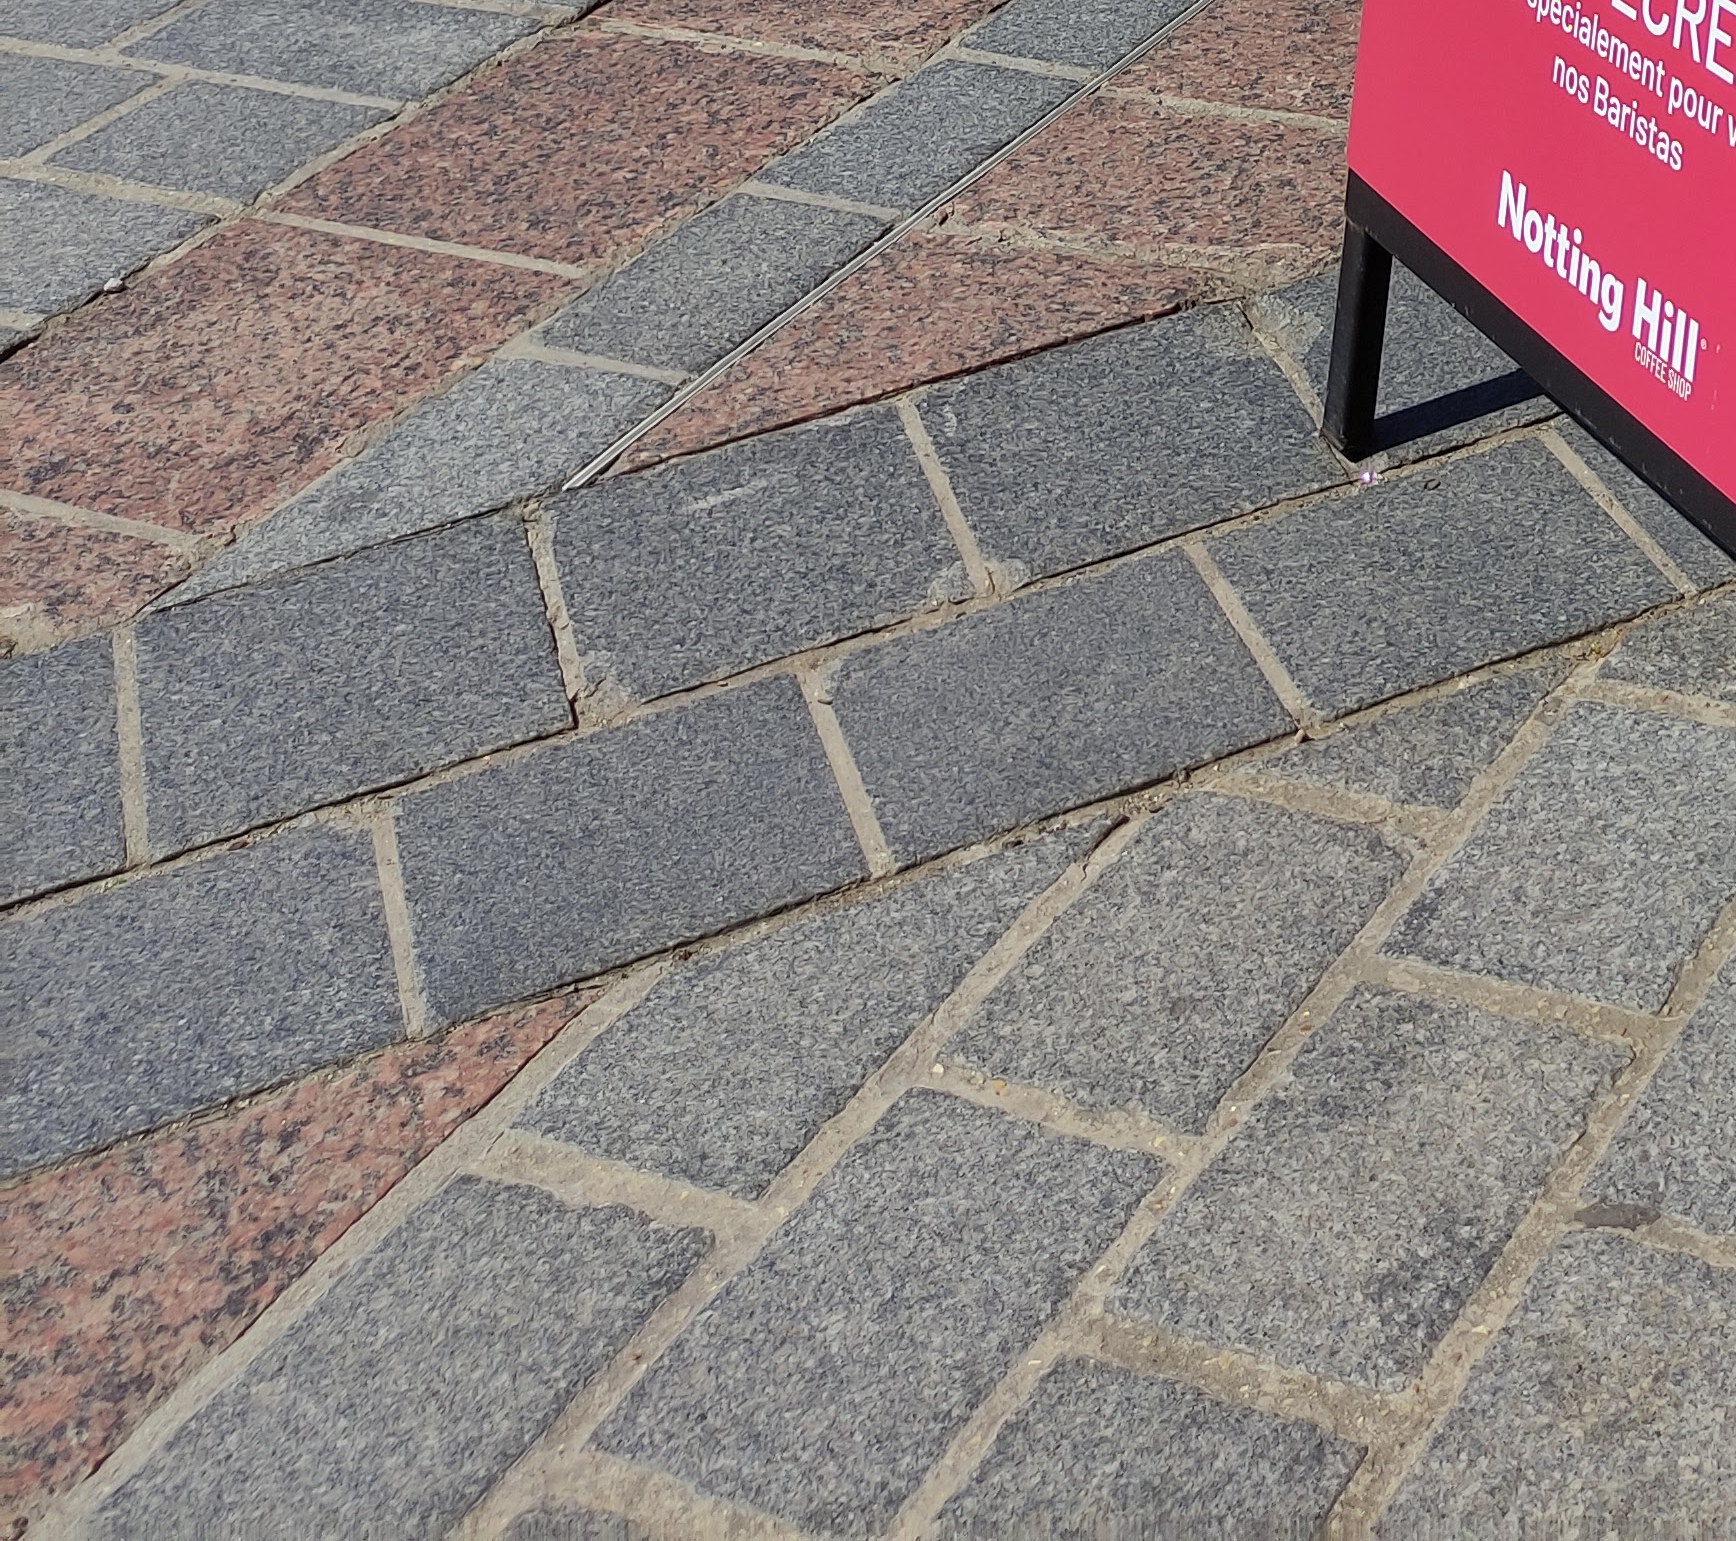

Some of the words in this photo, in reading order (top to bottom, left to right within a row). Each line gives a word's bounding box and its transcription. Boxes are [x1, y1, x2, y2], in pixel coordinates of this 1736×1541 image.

[1552, 54, 1590, 105] nos
[1593, 75, 1683, 171] Baristas
[1667, 76, 1724, 135] pour
[1497, 169, 1625, 333] Notting
[1631, 276, 1700, 384] Hill
[1633, 340, 1668, 385] COFFEE
[1667, 368, 1693, 403] SHOP
